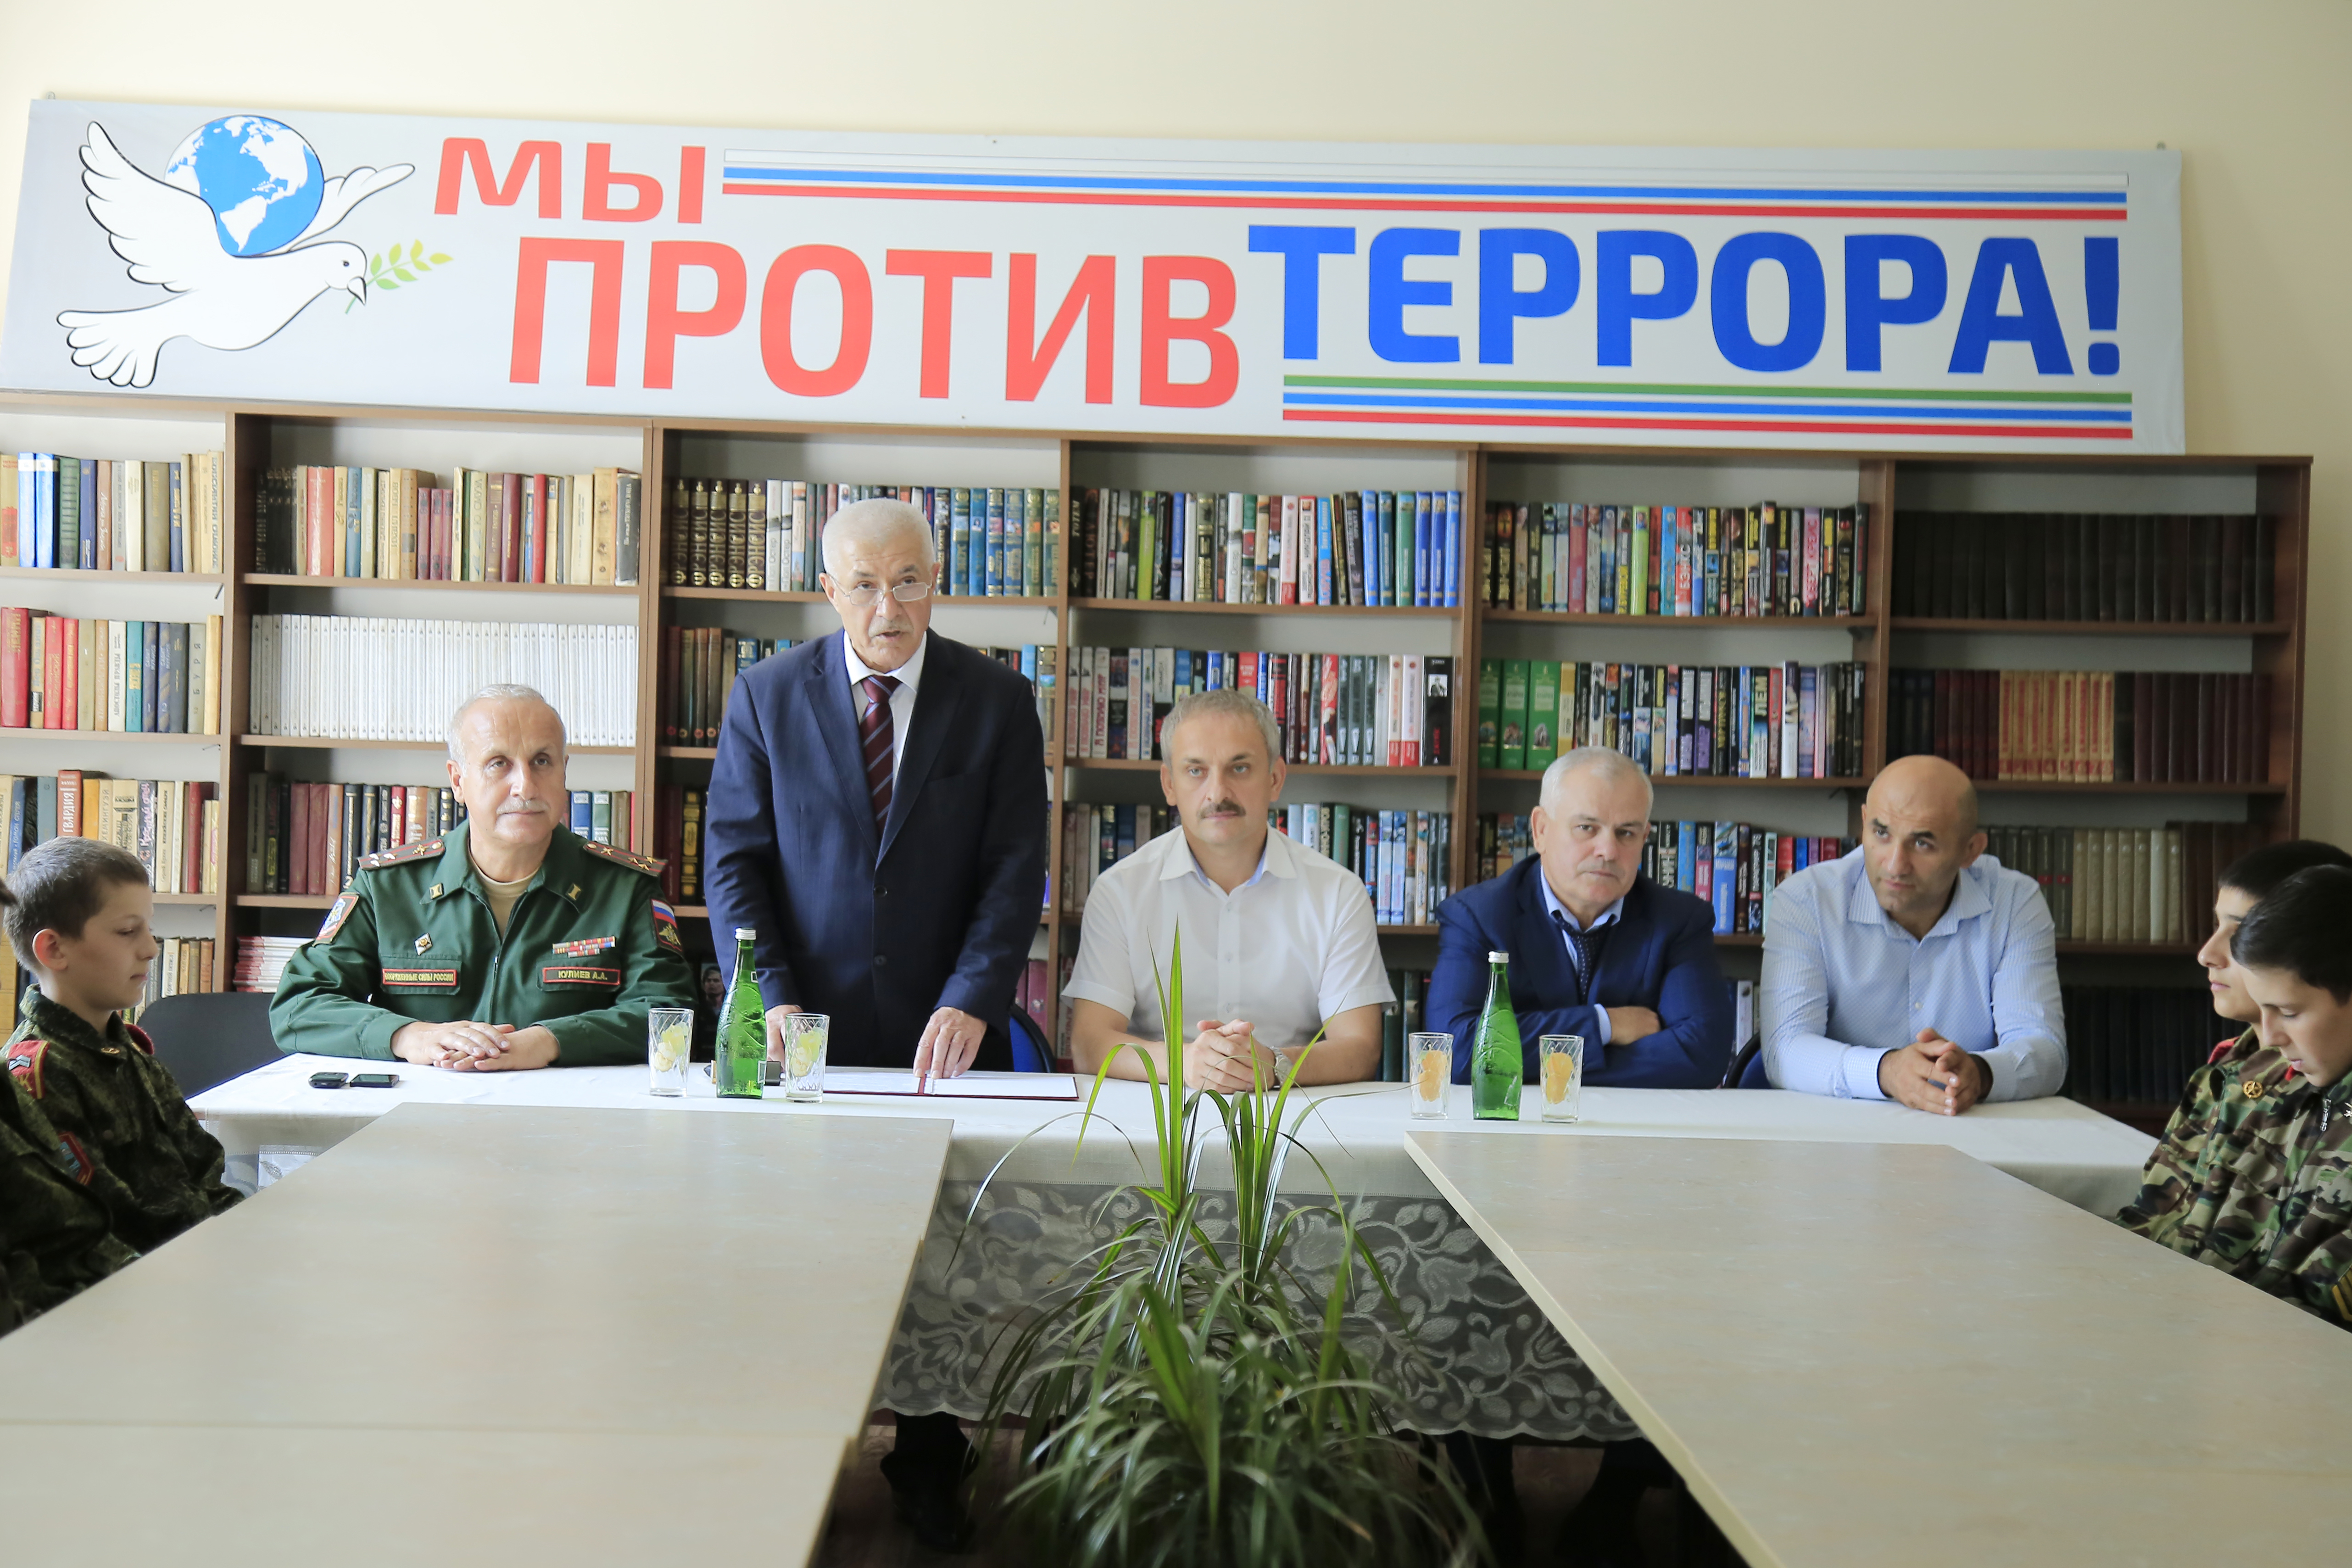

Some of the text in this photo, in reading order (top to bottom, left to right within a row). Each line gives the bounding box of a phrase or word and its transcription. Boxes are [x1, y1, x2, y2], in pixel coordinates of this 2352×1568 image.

[435, 137, 706, 224] МЫ
[510, 237, 1239, 408] ПРОТИВ
[1248, 224, 2120, 376] ТЕРРОРА!
[747, 512, 766, 588] ФРЭНСИС
[1680, 544, 1691, 589] БЭНКС
[193, 643, 201, 695] БУРЯ
[1755, 675, 1767, 716] ЛЕМ
[61, 792, 75, 833] ГВАРДИЯ
[385, 972, 454, 982] ВООРУЖЕННЫЕ СИЛЫ РОССИИ
[558, 970, 608, 981] КУЛИЕВ А.А.
